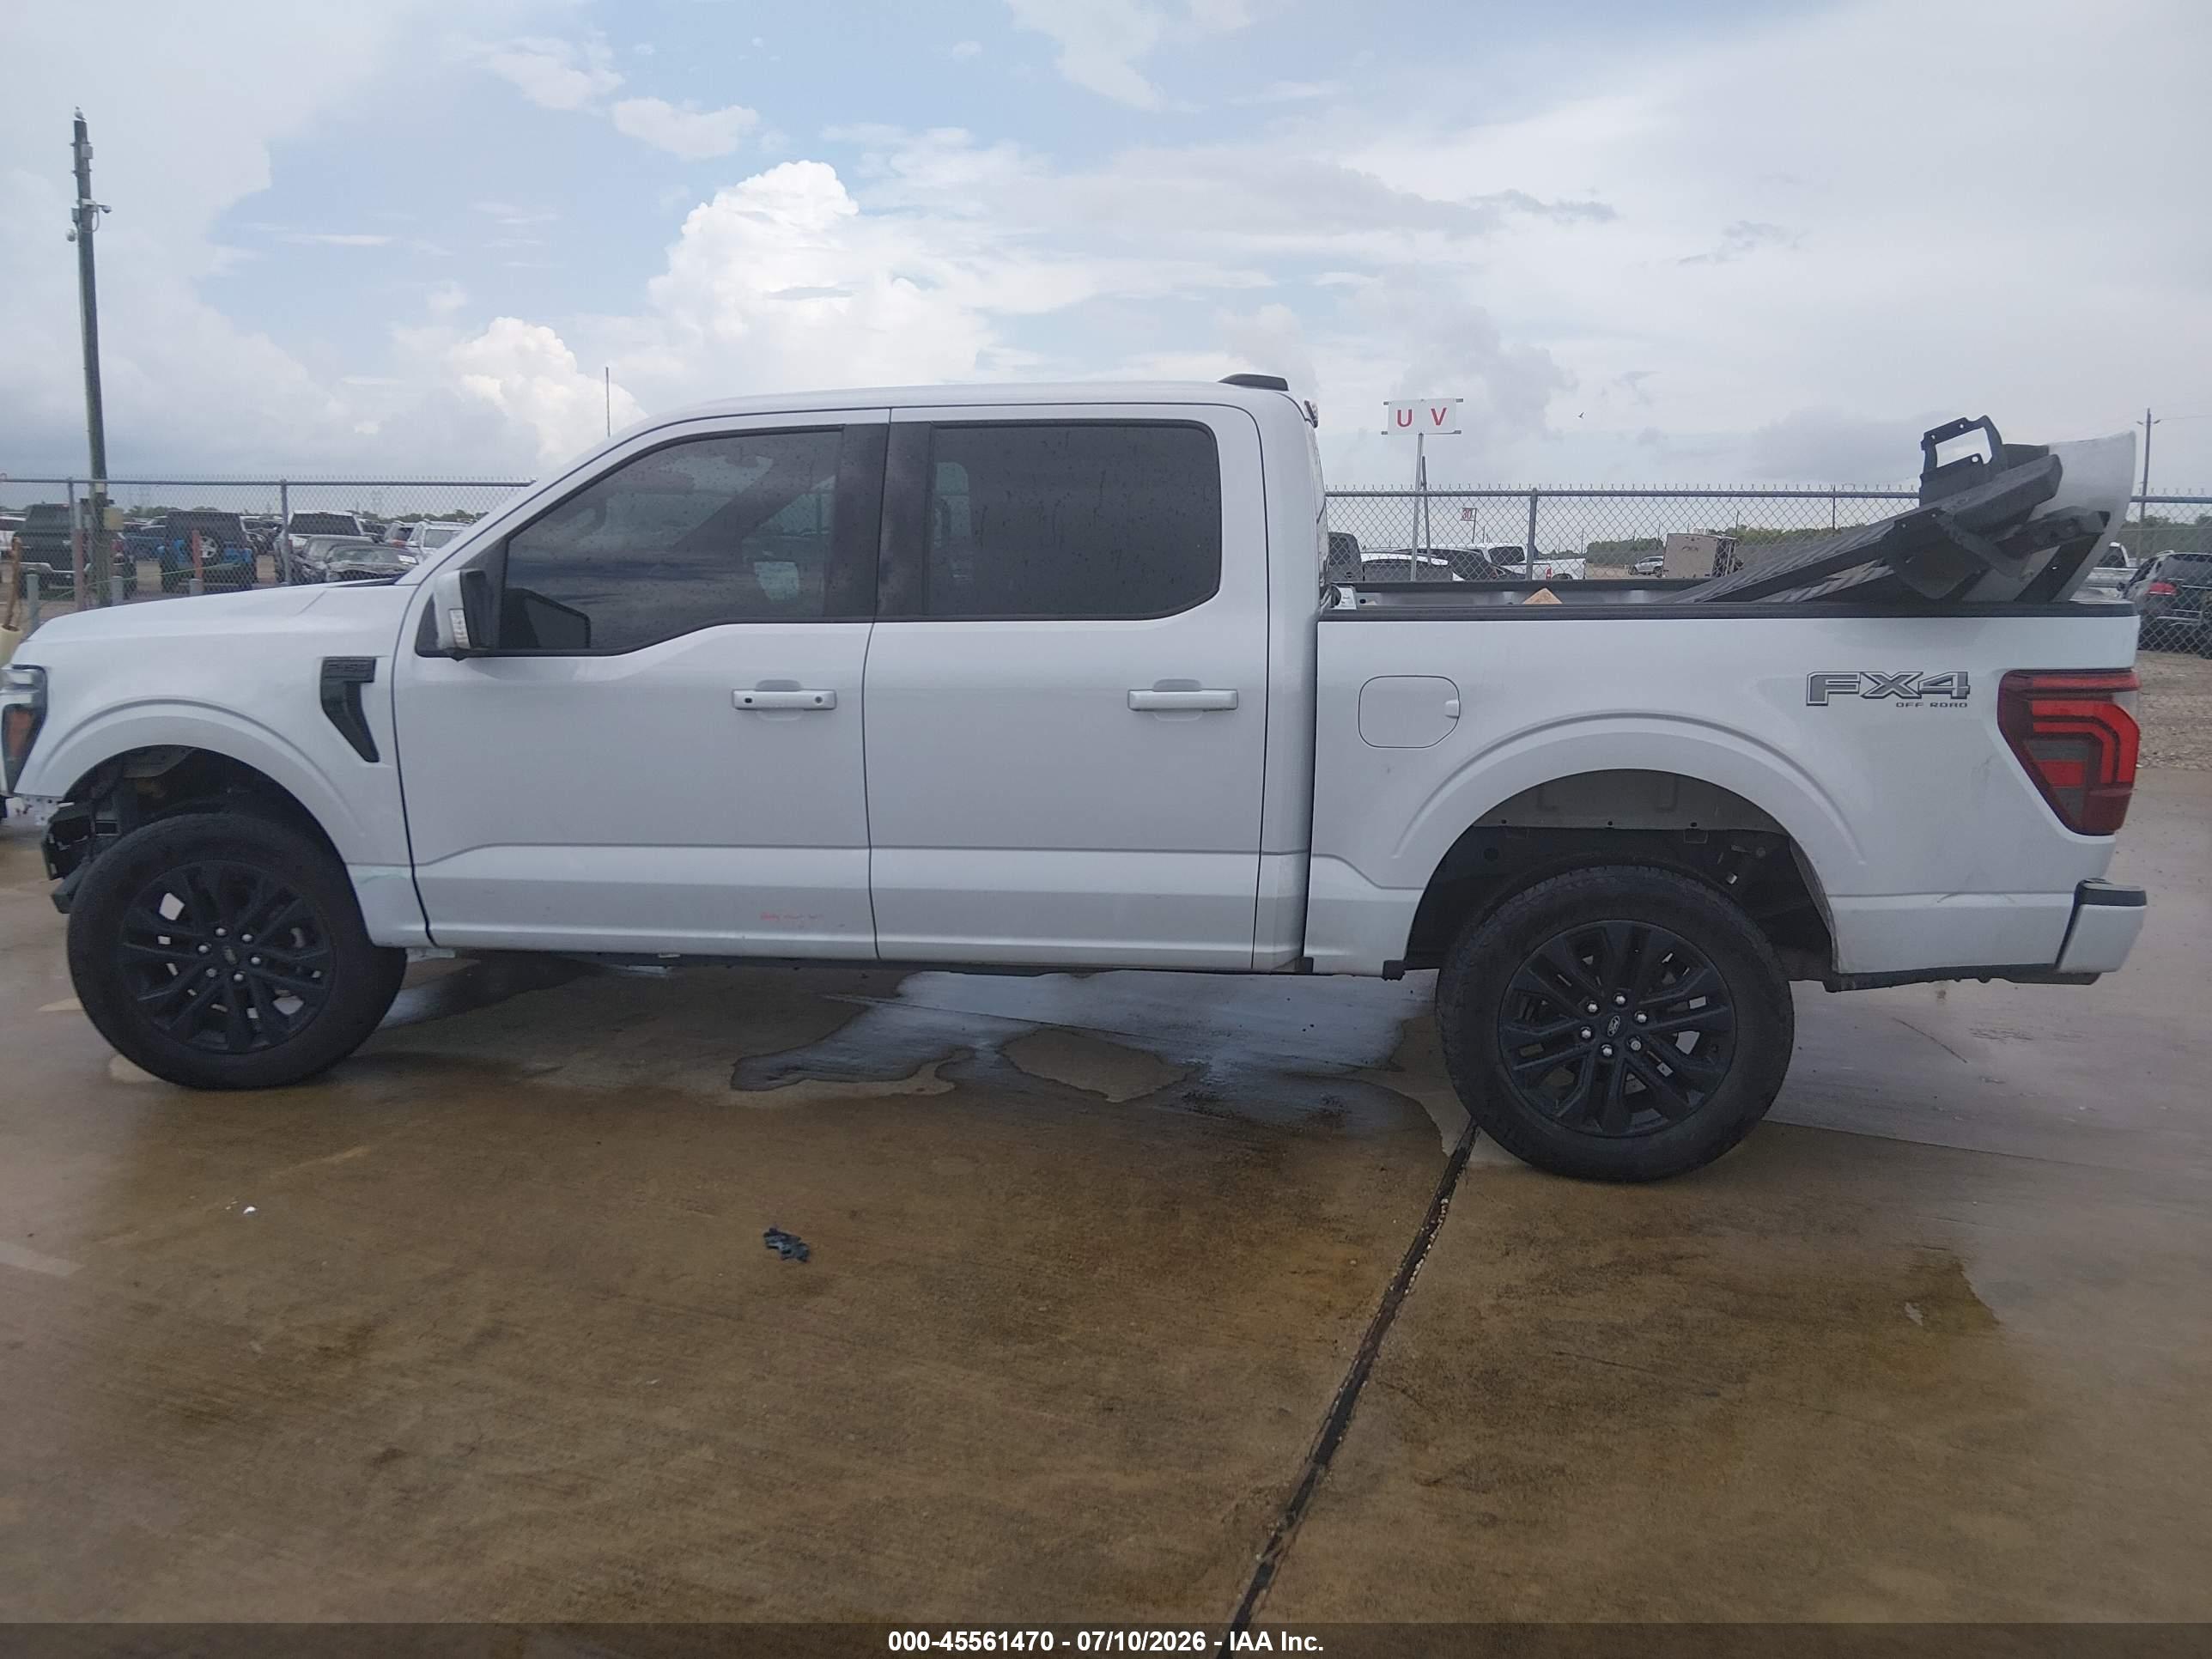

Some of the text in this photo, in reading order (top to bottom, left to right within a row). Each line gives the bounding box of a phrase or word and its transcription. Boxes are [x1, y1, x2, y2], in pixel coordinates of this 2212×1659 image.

[1396, 407, 1447, 428] U V
[1806, 672, 1971, 706] FX4
